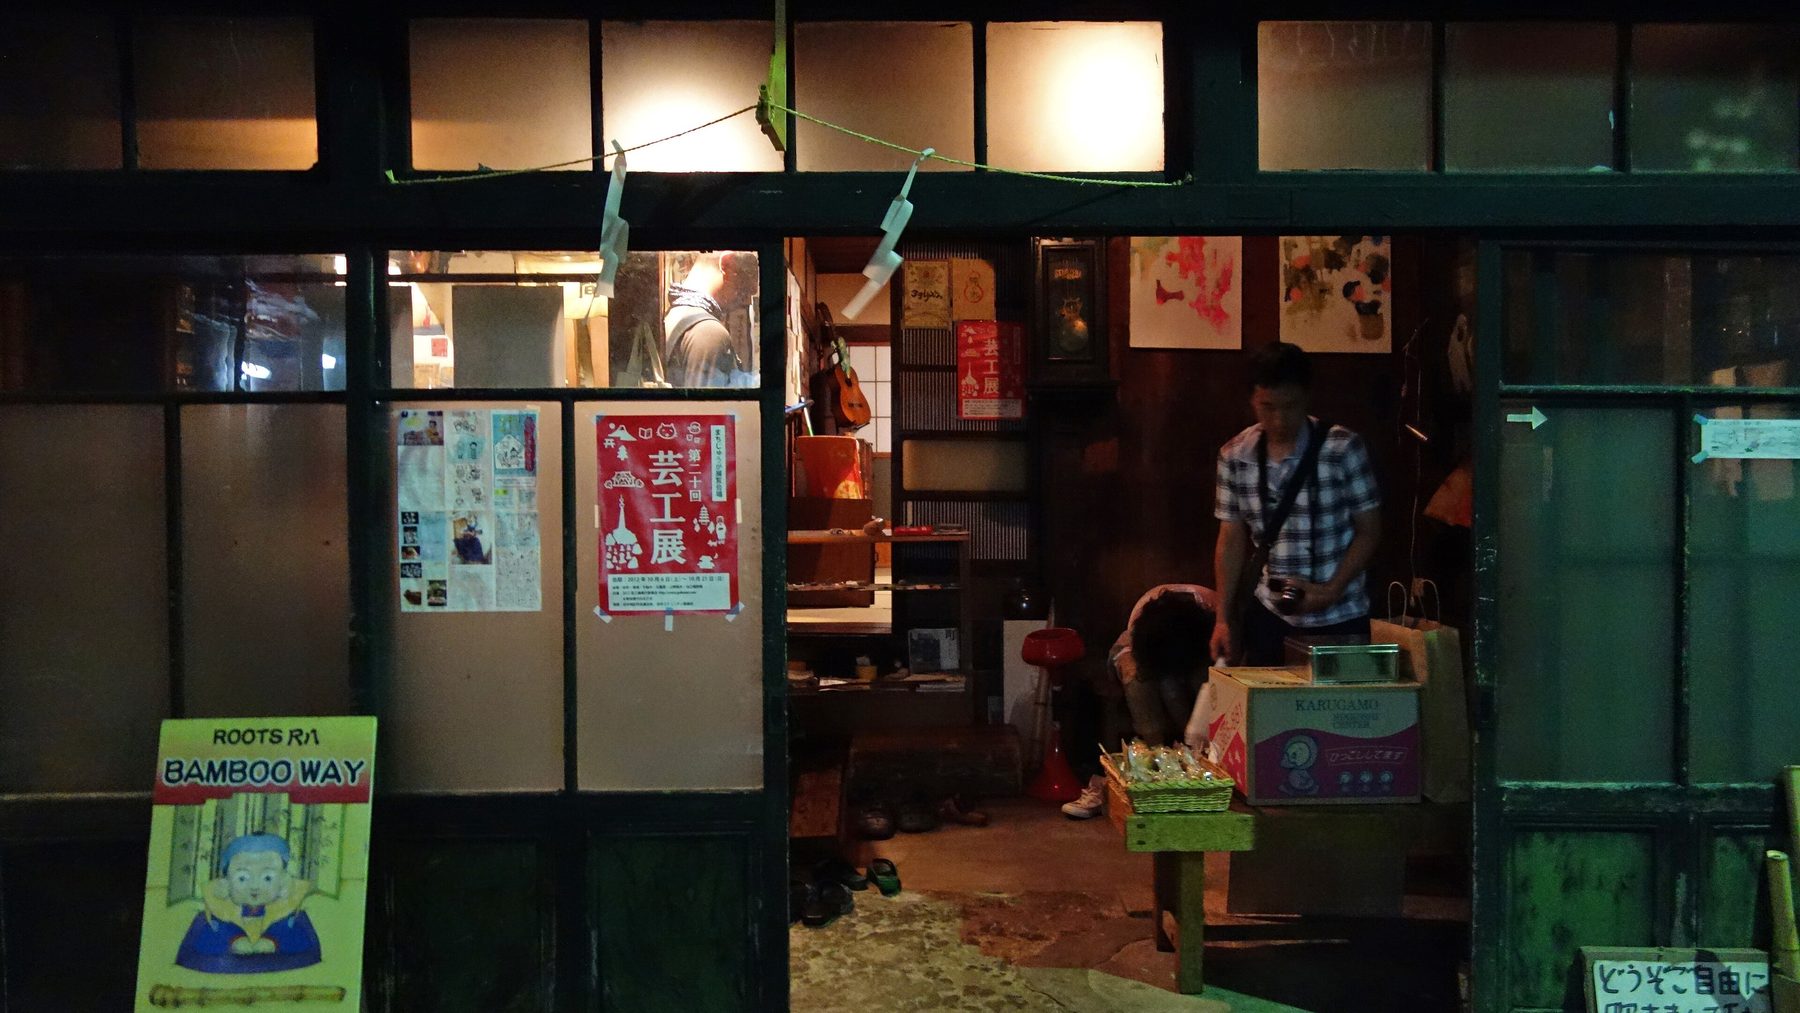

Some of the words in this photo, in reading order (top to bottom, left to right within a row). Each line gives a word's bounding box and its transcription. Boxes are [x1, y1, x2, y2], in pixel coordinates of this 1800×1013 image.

[688, 448, 702, 502] 第二十回
[648, 450, 687, 565] 芸工展
[1295, 699, 1379, 711] KARUGAMO
[213, 729, 283, 746] ROOTS
[163, 759, 293, 785] BAMBOO
[299, 759, 365, 784] WAY
[1599, 964, 1767, 995] どうぞご自由に
